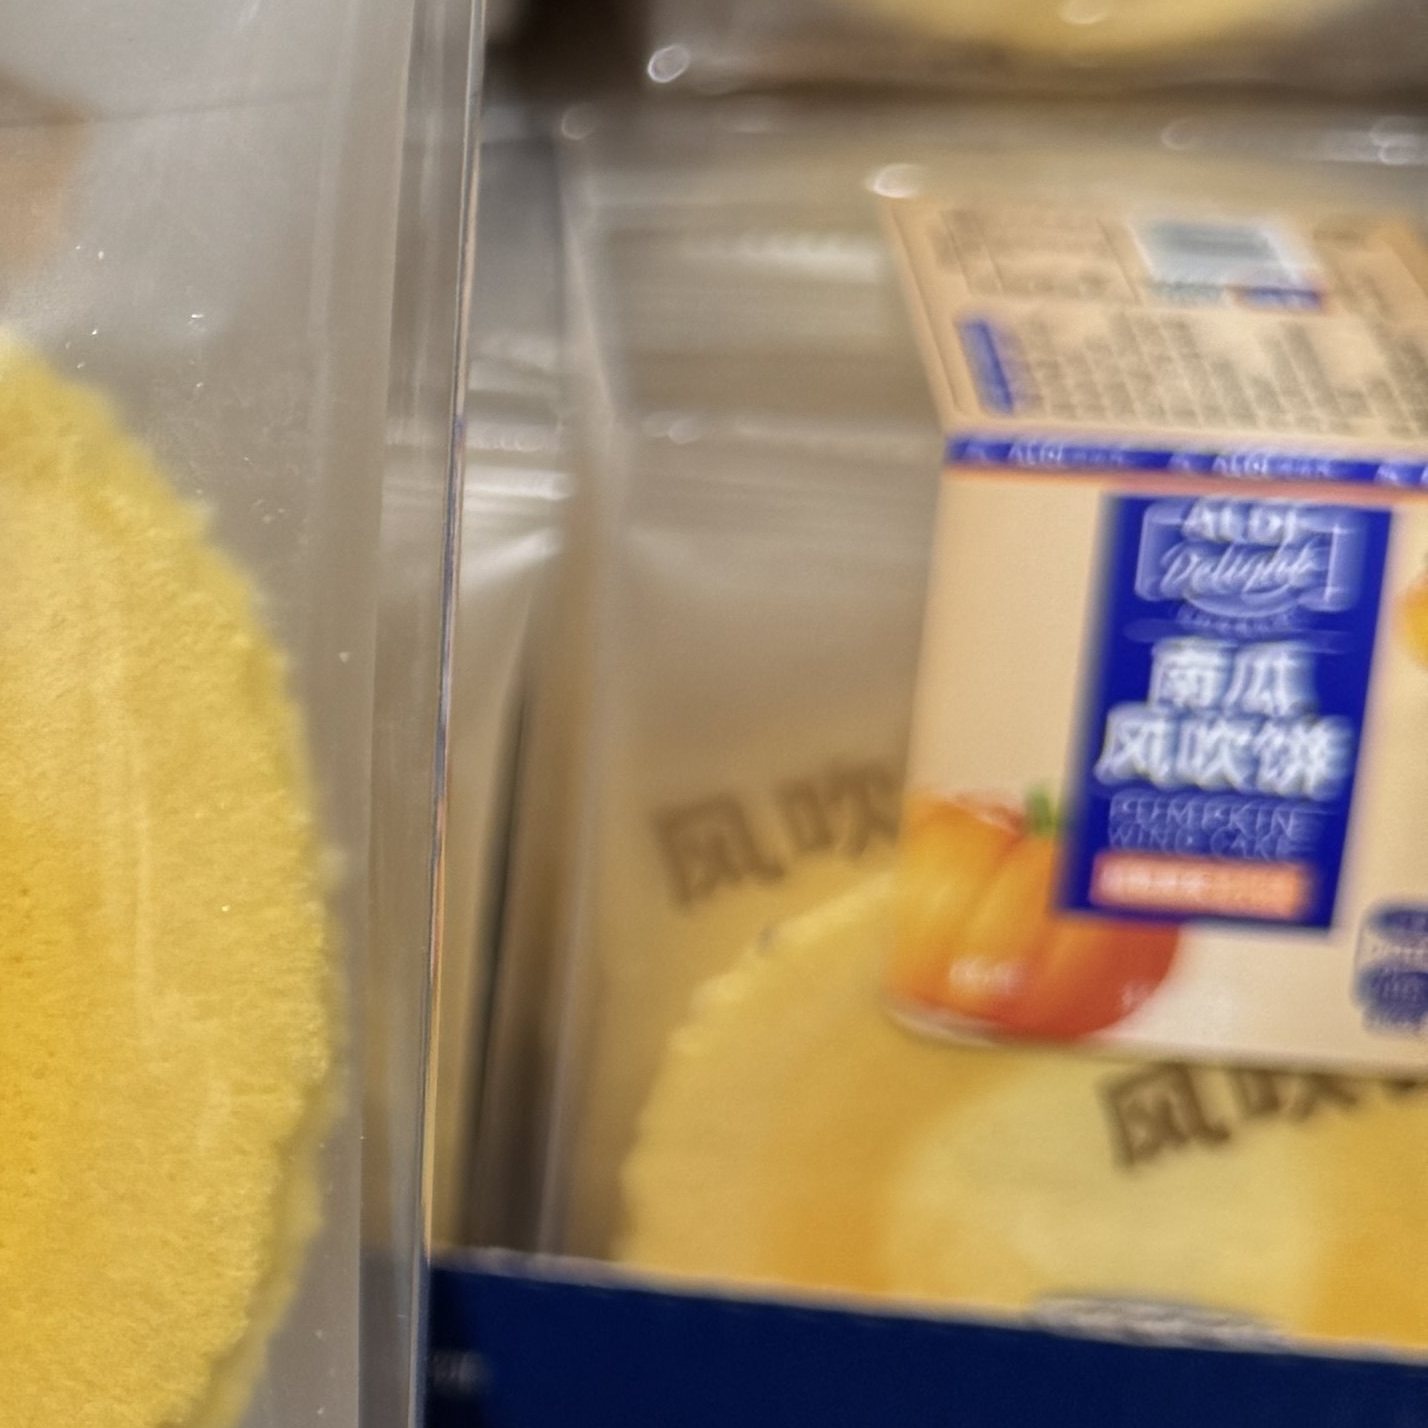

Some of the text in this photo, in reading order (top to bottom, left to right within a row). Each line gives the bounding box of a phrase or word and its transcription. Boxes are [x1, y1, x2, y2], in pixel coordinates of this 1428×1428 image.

[1146, 638, 1314, 718] 南瓜
[1096, 703, 1349, 800] 风吹饼
